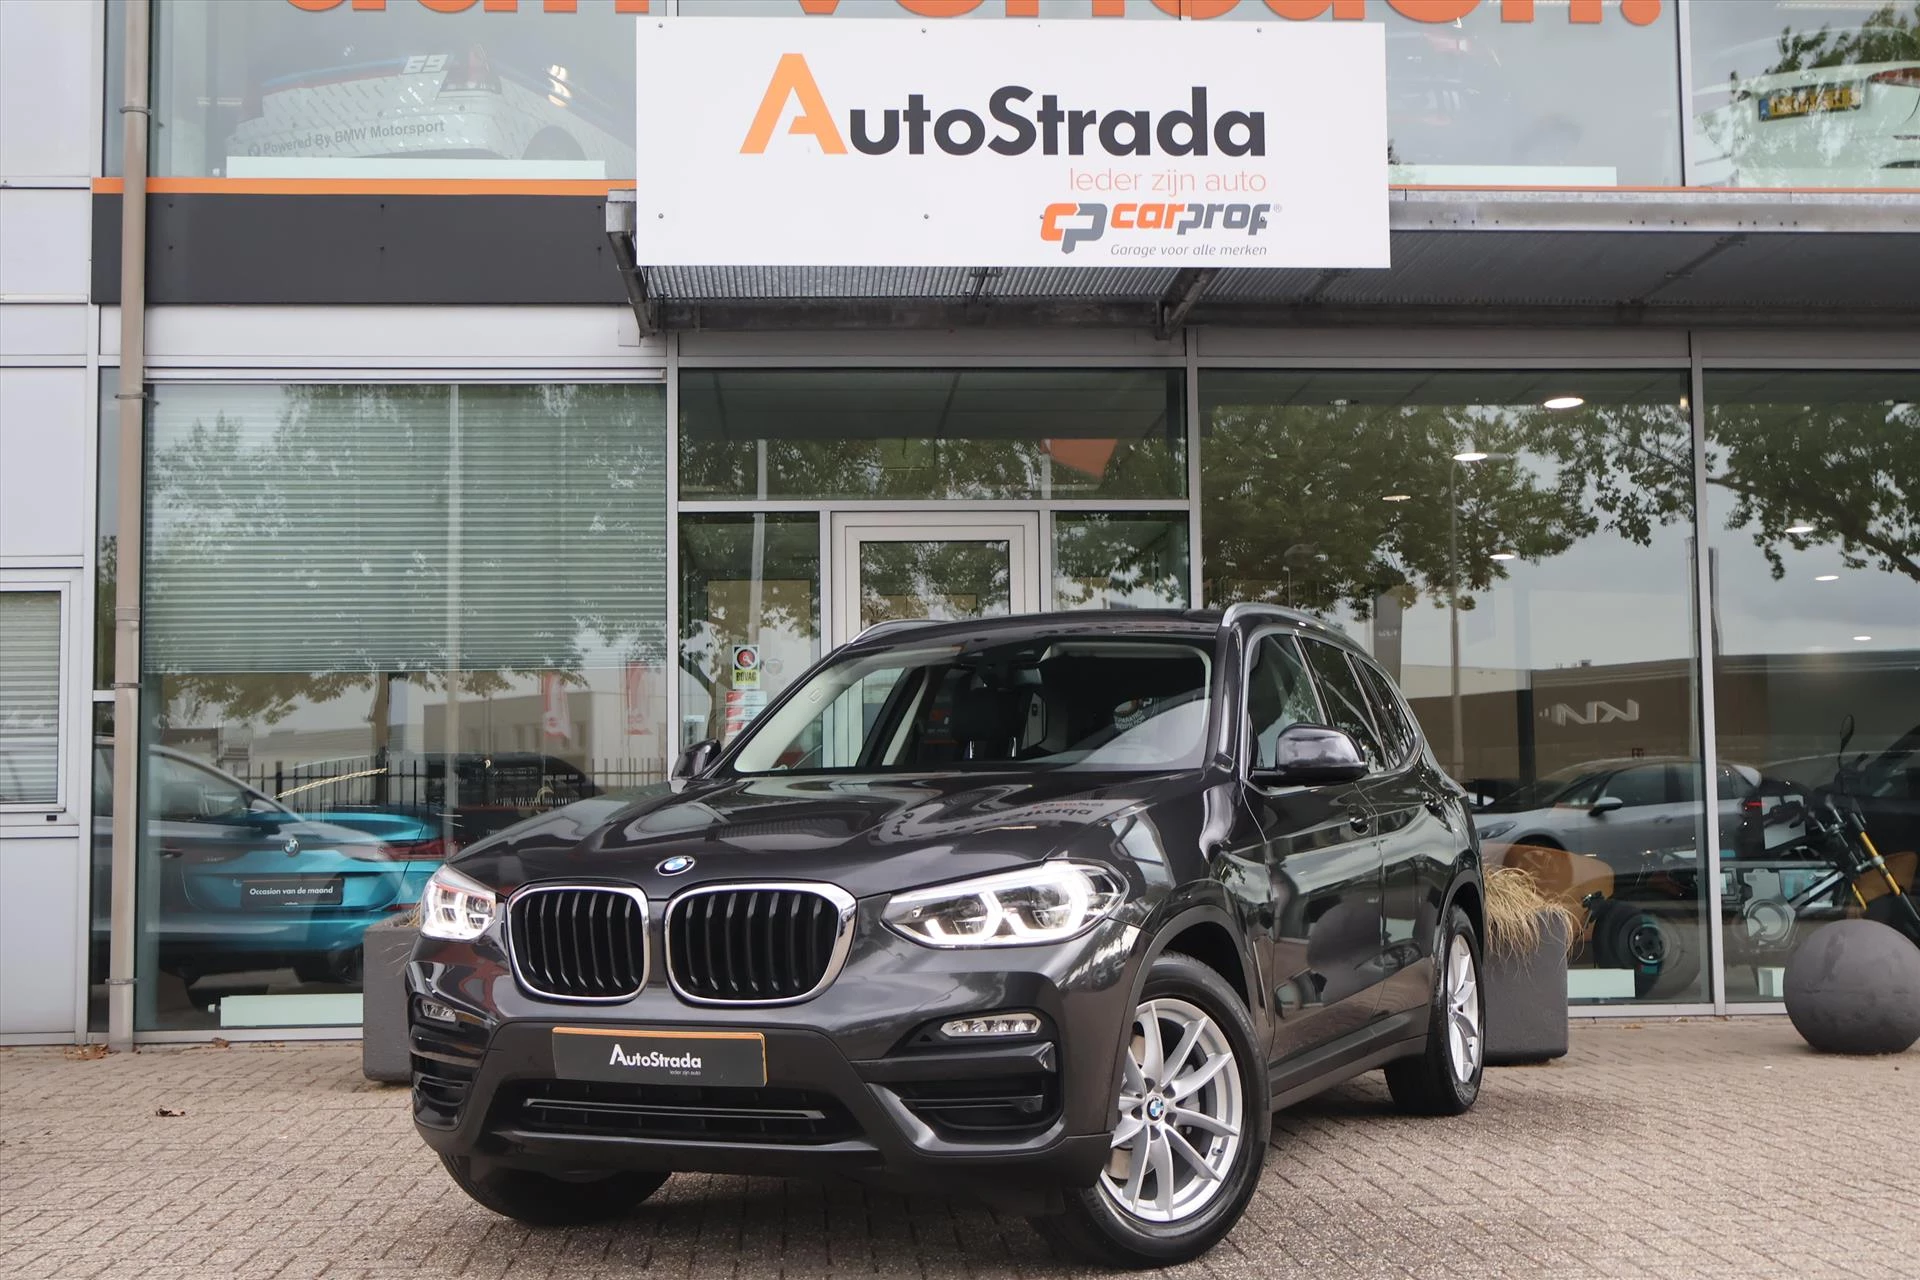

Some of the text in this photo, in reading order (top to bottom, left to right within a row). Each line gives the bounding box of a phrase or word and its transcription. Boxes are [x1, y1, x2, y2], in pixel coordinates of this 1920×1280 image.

[402, 54, 447, 74] 69
[740, 53, 1266, 157] AutoStrada
[264, 119, 446, 154] Powered By BMW Motorsport
[1070, 167, 1267, 197] Ieder zijn auto
[1110, 243, 1267, 258] Garage voor alle merken
[736, 672, 756, 681] BOVAG
[297, 886, 306, 895] de
[307, 886, 333, 894] maand
[609, 1043, 702, 1069] AutoStrada
